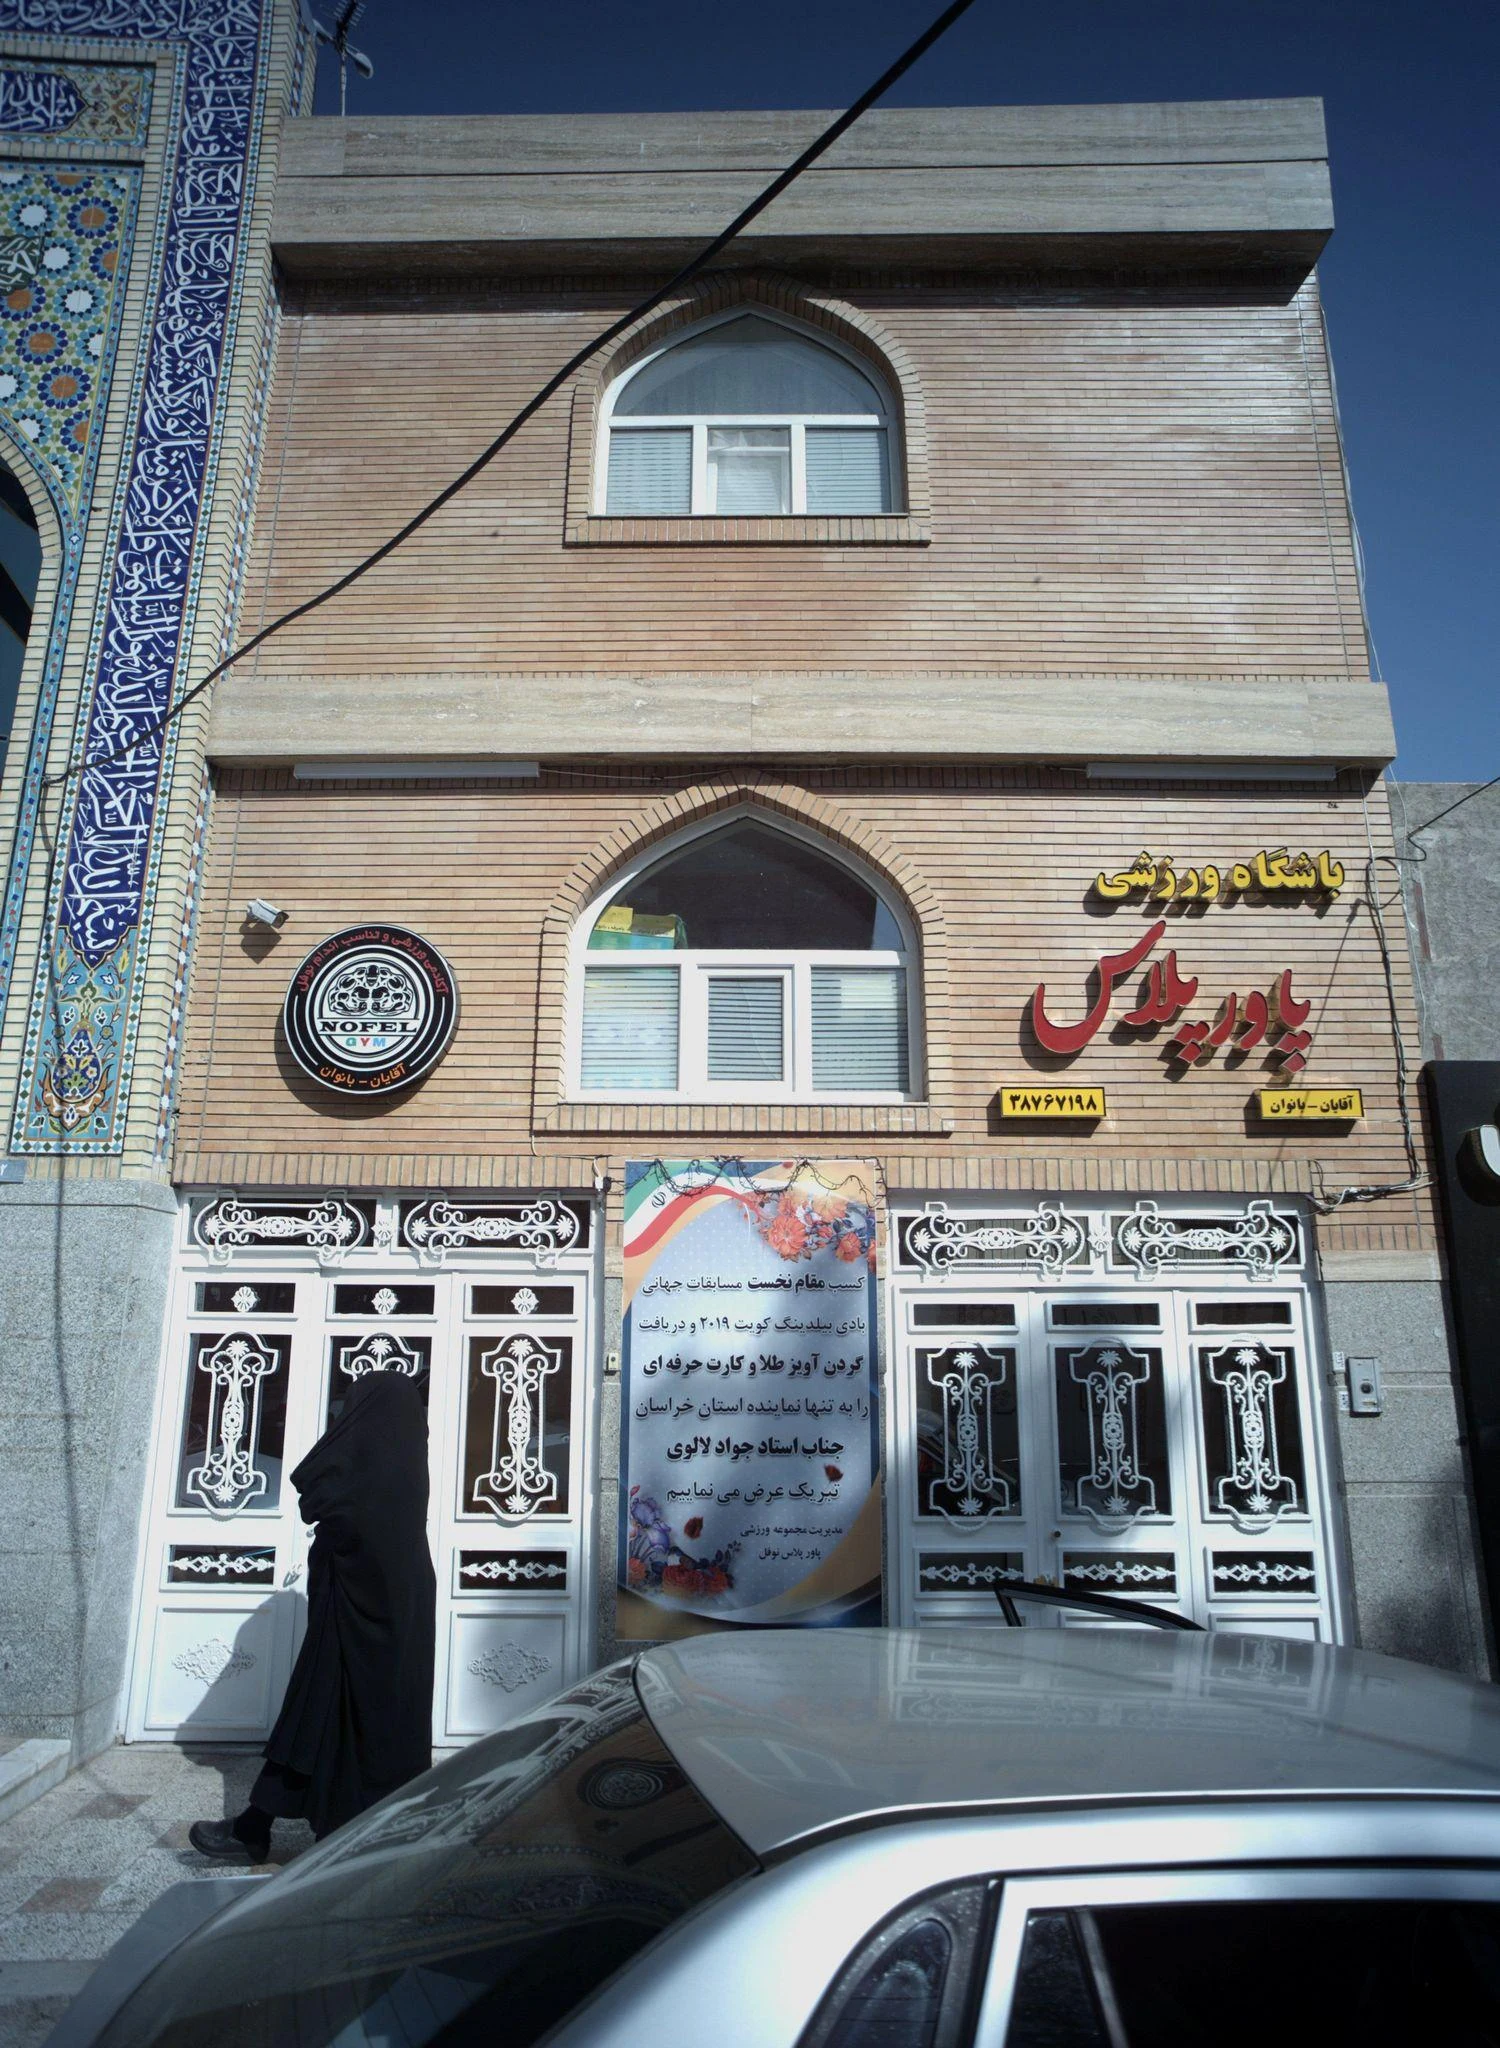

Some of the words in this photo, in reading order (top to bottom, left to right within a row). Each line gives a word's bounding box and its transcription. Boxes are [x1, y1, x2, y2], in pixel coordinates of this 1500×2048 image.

[1097, 849, 1220, 899] ورزشی
[1234, 846, 1345, 901] باشگاه
[340, 929, 381, 946] تناسب
[319, 1021, 418, 1033] NOFEL
[345, 1037, 387, 1048] GYM
[319, 1064, 355, 1085] بانوان
[369, 1062, 407, 1087] آقایان
[1010, 1093, 1097, 1112] ۳۸۷۶۷۱۹۸
[641, 1276, 683, 1296] جهانی
[686, 1276, 743, 1294] مسابقات
[747, 1272, 792, 1292] نخست
[795, 1273, 826, 1293] مقام
[828, 1276, 865, 1292] کسب
[638, 1316, 686, 1335] دریافت
[689, 1322, 697, 1334] و
[699, 1316, 730, 1330] ۲۰۱۹
[734, 1317, 771, 1335] کویت
[835, 1316, 866, 1335] بادی
[705, 1354, 745, 1377] کارت
[748, 1361, 757, 1376] و
[759, 1353, 785, 1372] طلا
[788, 1352, 821, 1377] آویز
[635, 1397, 695, 1418] خراسان
[698, 1398, 743, 1419] استان
[747, 1397, 802, 1418] نماینده
[805, 1398, 834, 1418] تنها
[838, 1401, 854, 1415] به
[714, 1437, 755, 1460] جواد
[758, 1437, 799, 1455] استاد
[801, 1437, 845, 1460] جناب
[716, 1487, 741, 1504] می
[743, 1485, 784, 1505] عرض
[788, 1482, 840, 1504] تبریک
[740, 1523, 770, 1538] ورزشی
[773, 1526, 807, 1538] مجموعه
